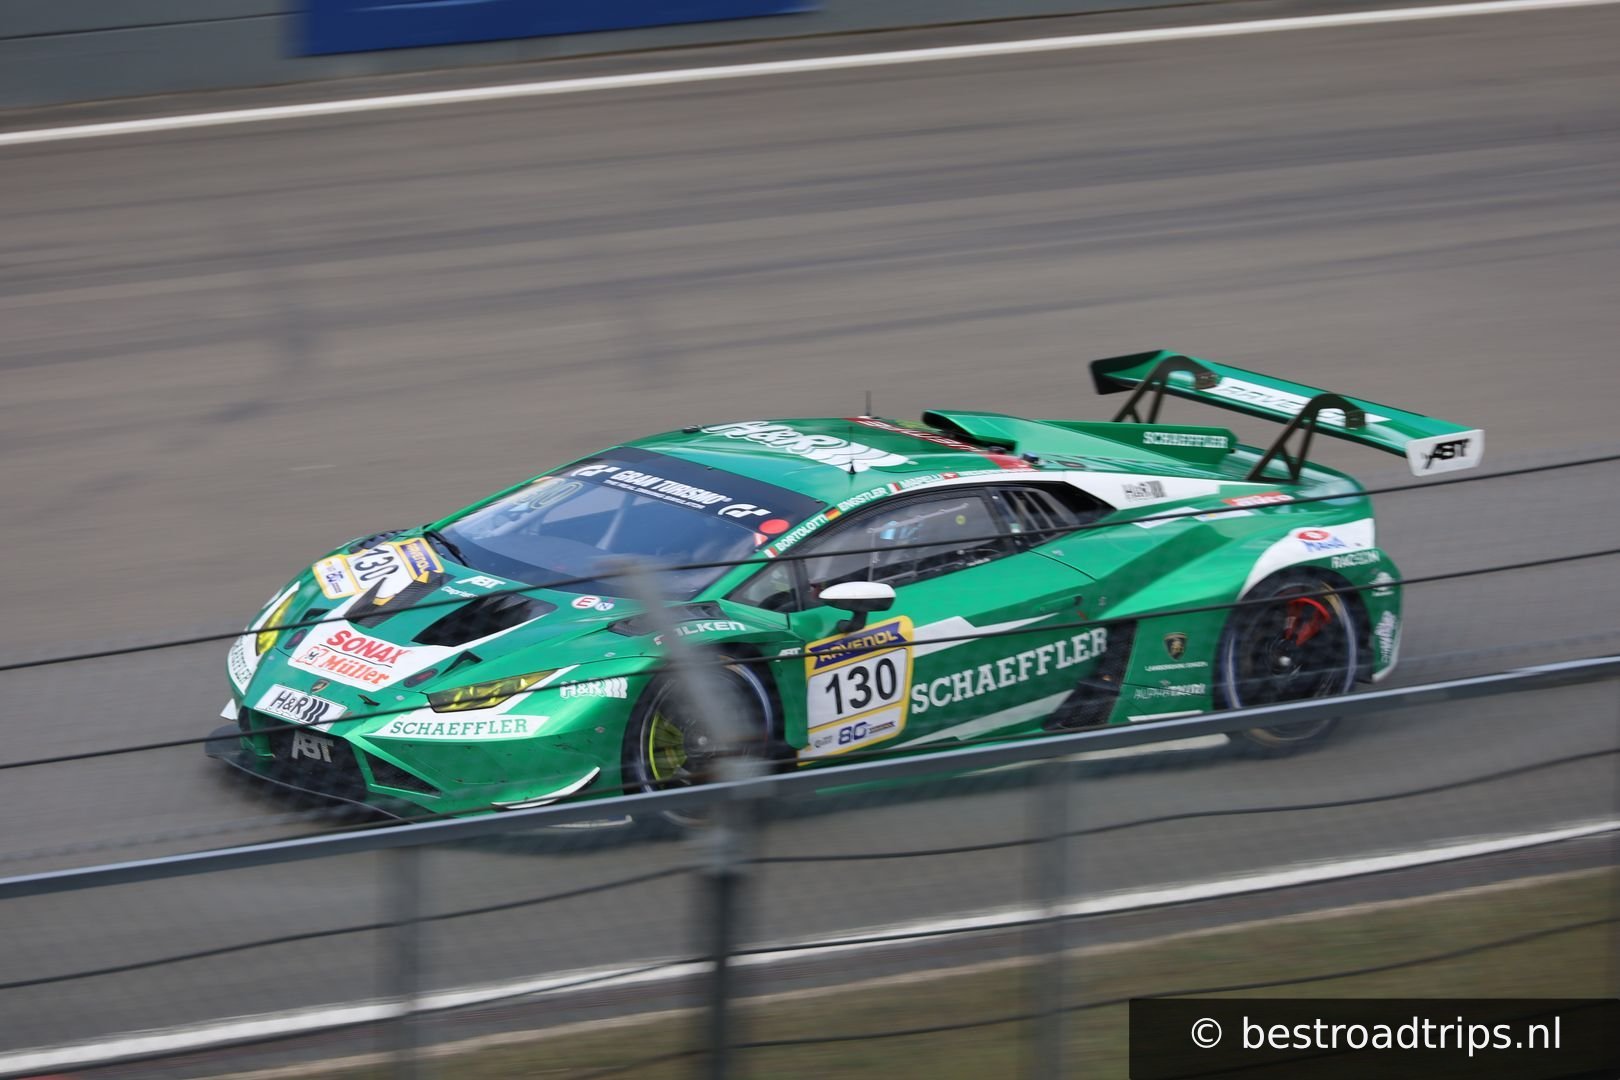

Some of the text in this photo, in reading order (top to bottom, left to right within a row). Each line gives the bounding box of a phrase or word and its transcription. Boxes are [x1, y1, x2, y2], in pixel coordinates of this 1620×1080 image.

[1425, 438, 1471, 469] ABT
[610, 470, 654, 488] GRAN
[655, 478, 728, 504] TURISMO
[776, 513, 829, 551] BORTOLOTTI
[354, 548, 399, 582] 130
[456, 575, 506, 589] ABT
[326, 630, 410, 664] SONAX
[654, 621, 746, 646] LKEN
[319, 655, 390, 684] Müller
[911, 627, 1107, 714] SCHAEFFLER
[825, 658, 897, 715] 130
[390, 718, 528, 736] SCHAEFFLER
[291, 730, 334, 763] ABT
